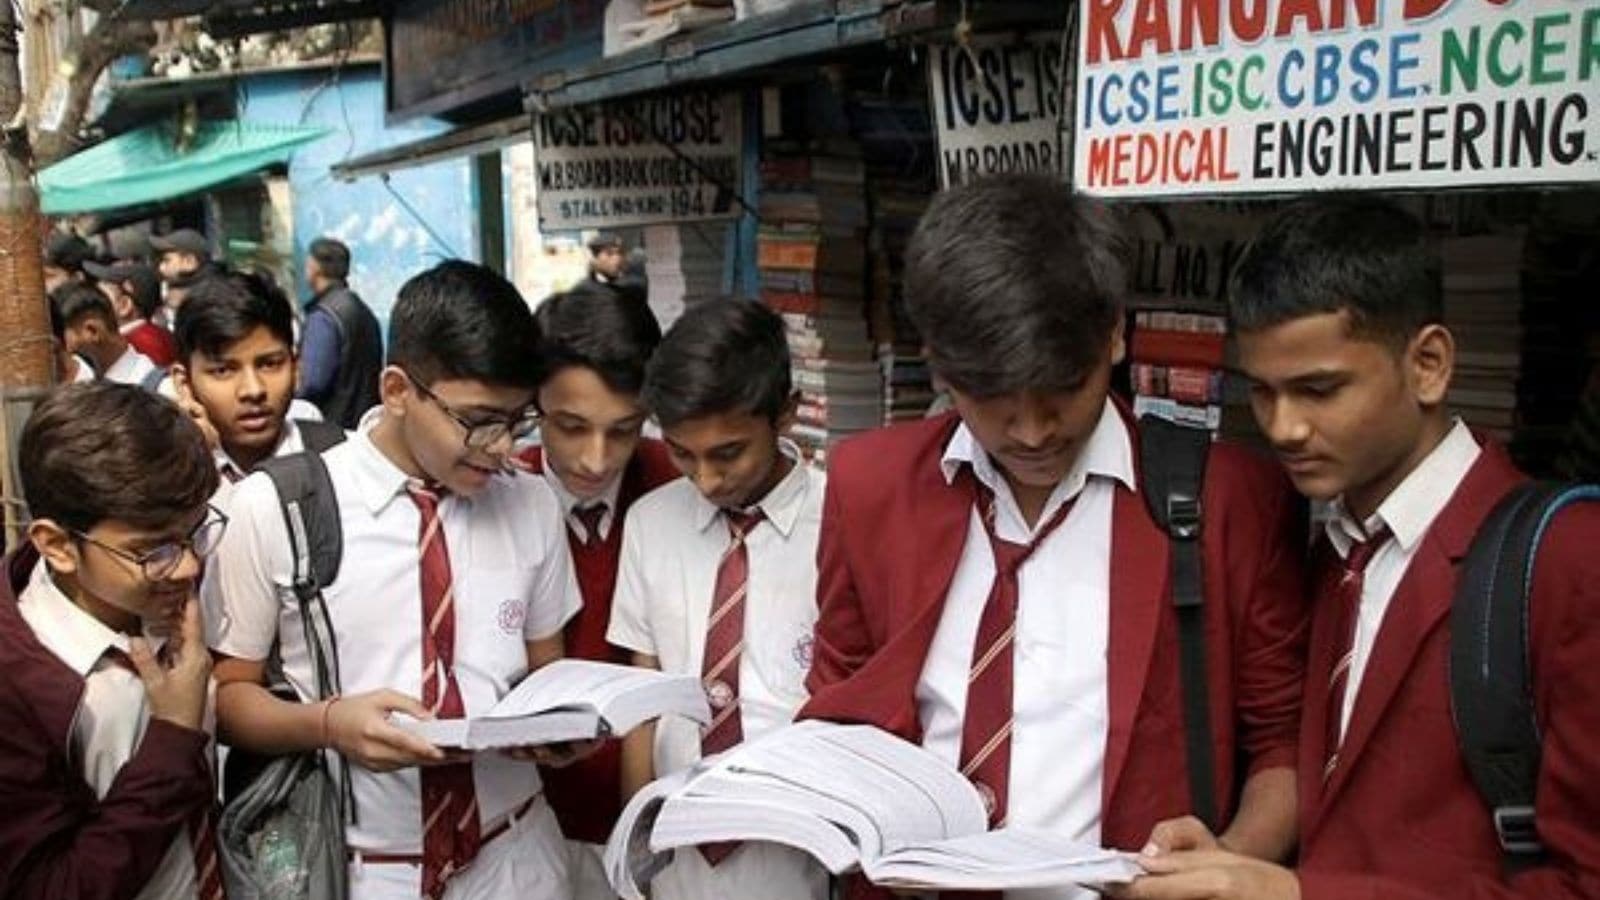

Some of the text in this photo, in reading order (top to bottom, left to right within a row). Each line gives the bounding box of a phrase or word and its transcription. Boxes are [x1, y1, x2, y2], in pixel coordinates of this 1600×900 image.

[651, 96, 721, 145] CBSE
[1086, 128, 1239, 186] MEDICAL
[560, 197, 608, 219] STALL
